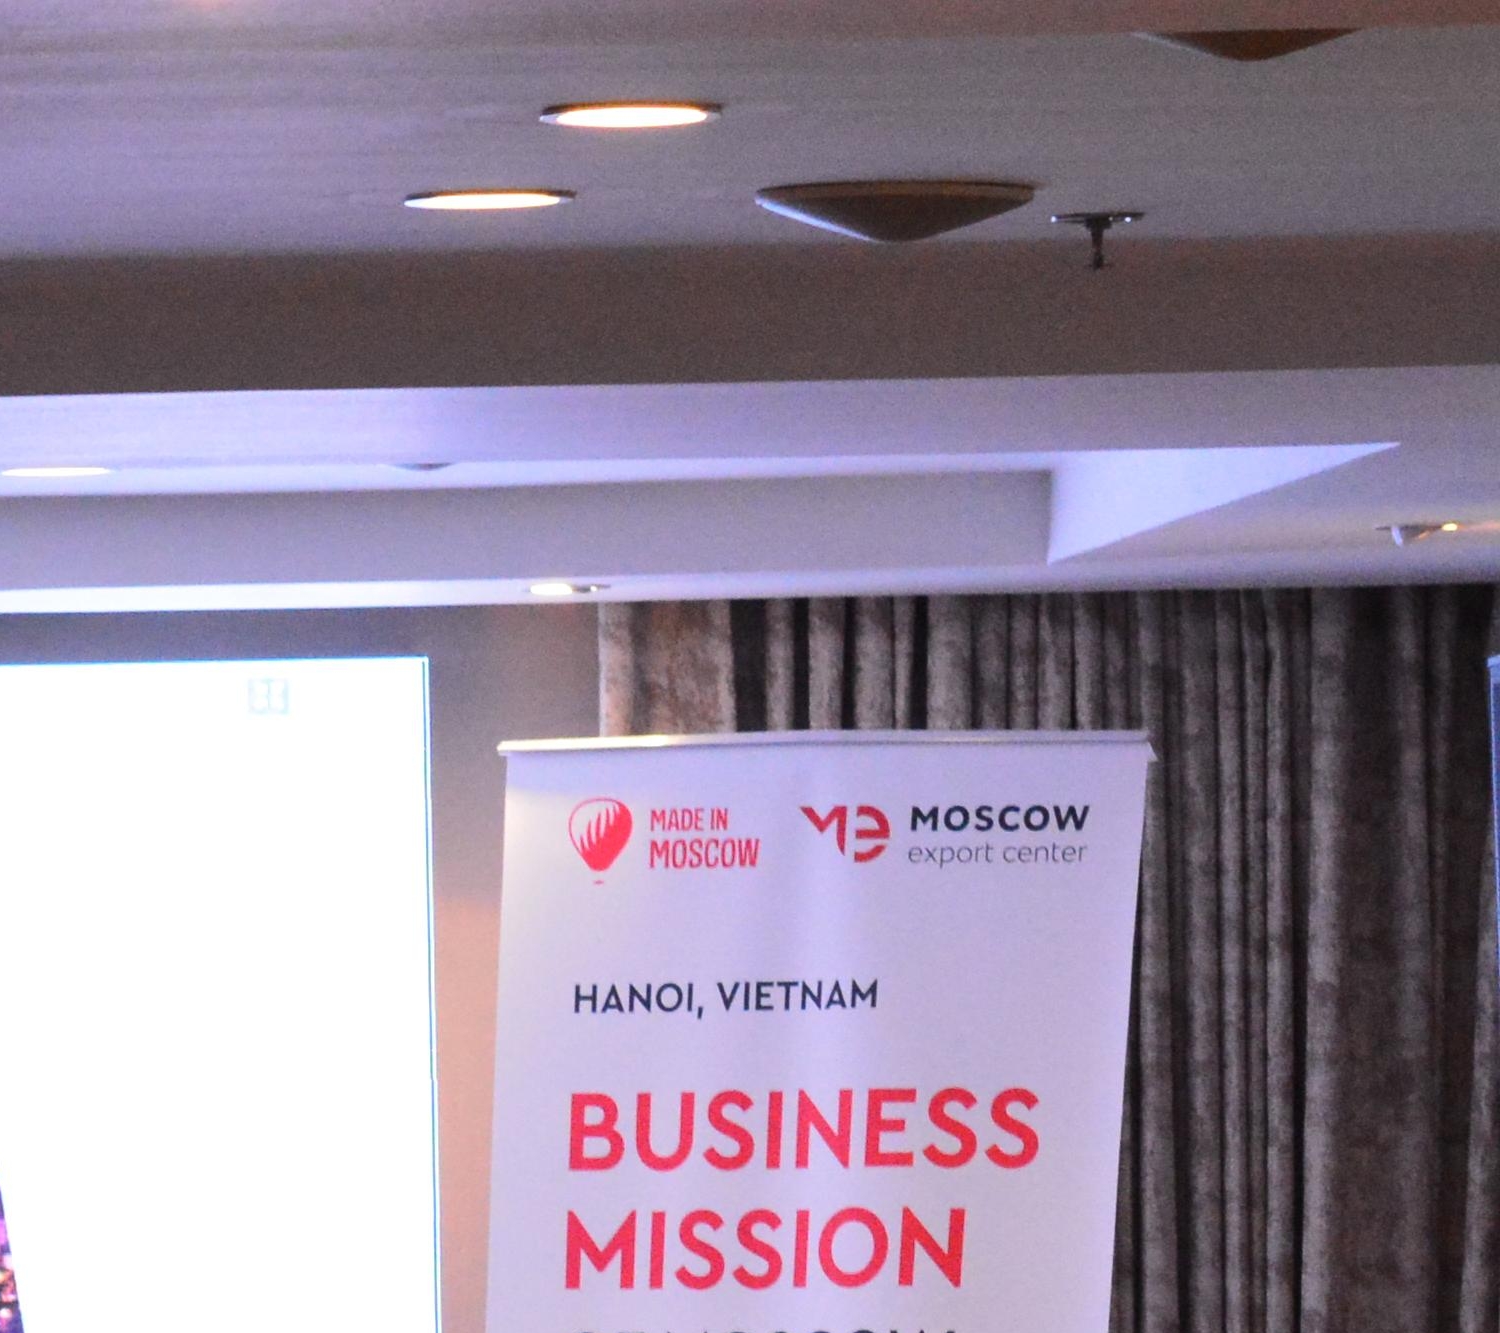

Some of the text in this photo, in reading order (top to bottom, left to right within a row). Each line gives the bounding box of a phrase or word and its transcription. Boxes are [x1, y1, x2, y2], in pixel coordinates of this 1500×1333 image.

[650, 807, 728, 832] MADE IN
[910, 805, 1091, 832] MOSCOW
[649, 838, 760, 869] MOSCOW
[907, 842, 1088, 868] export center
[574, 979, 878, 1019] HANOI, VIETNAM
[568, 1087, 1041, 1172] BUSINESS
[564, 1205, 967, 1291] MISSION
